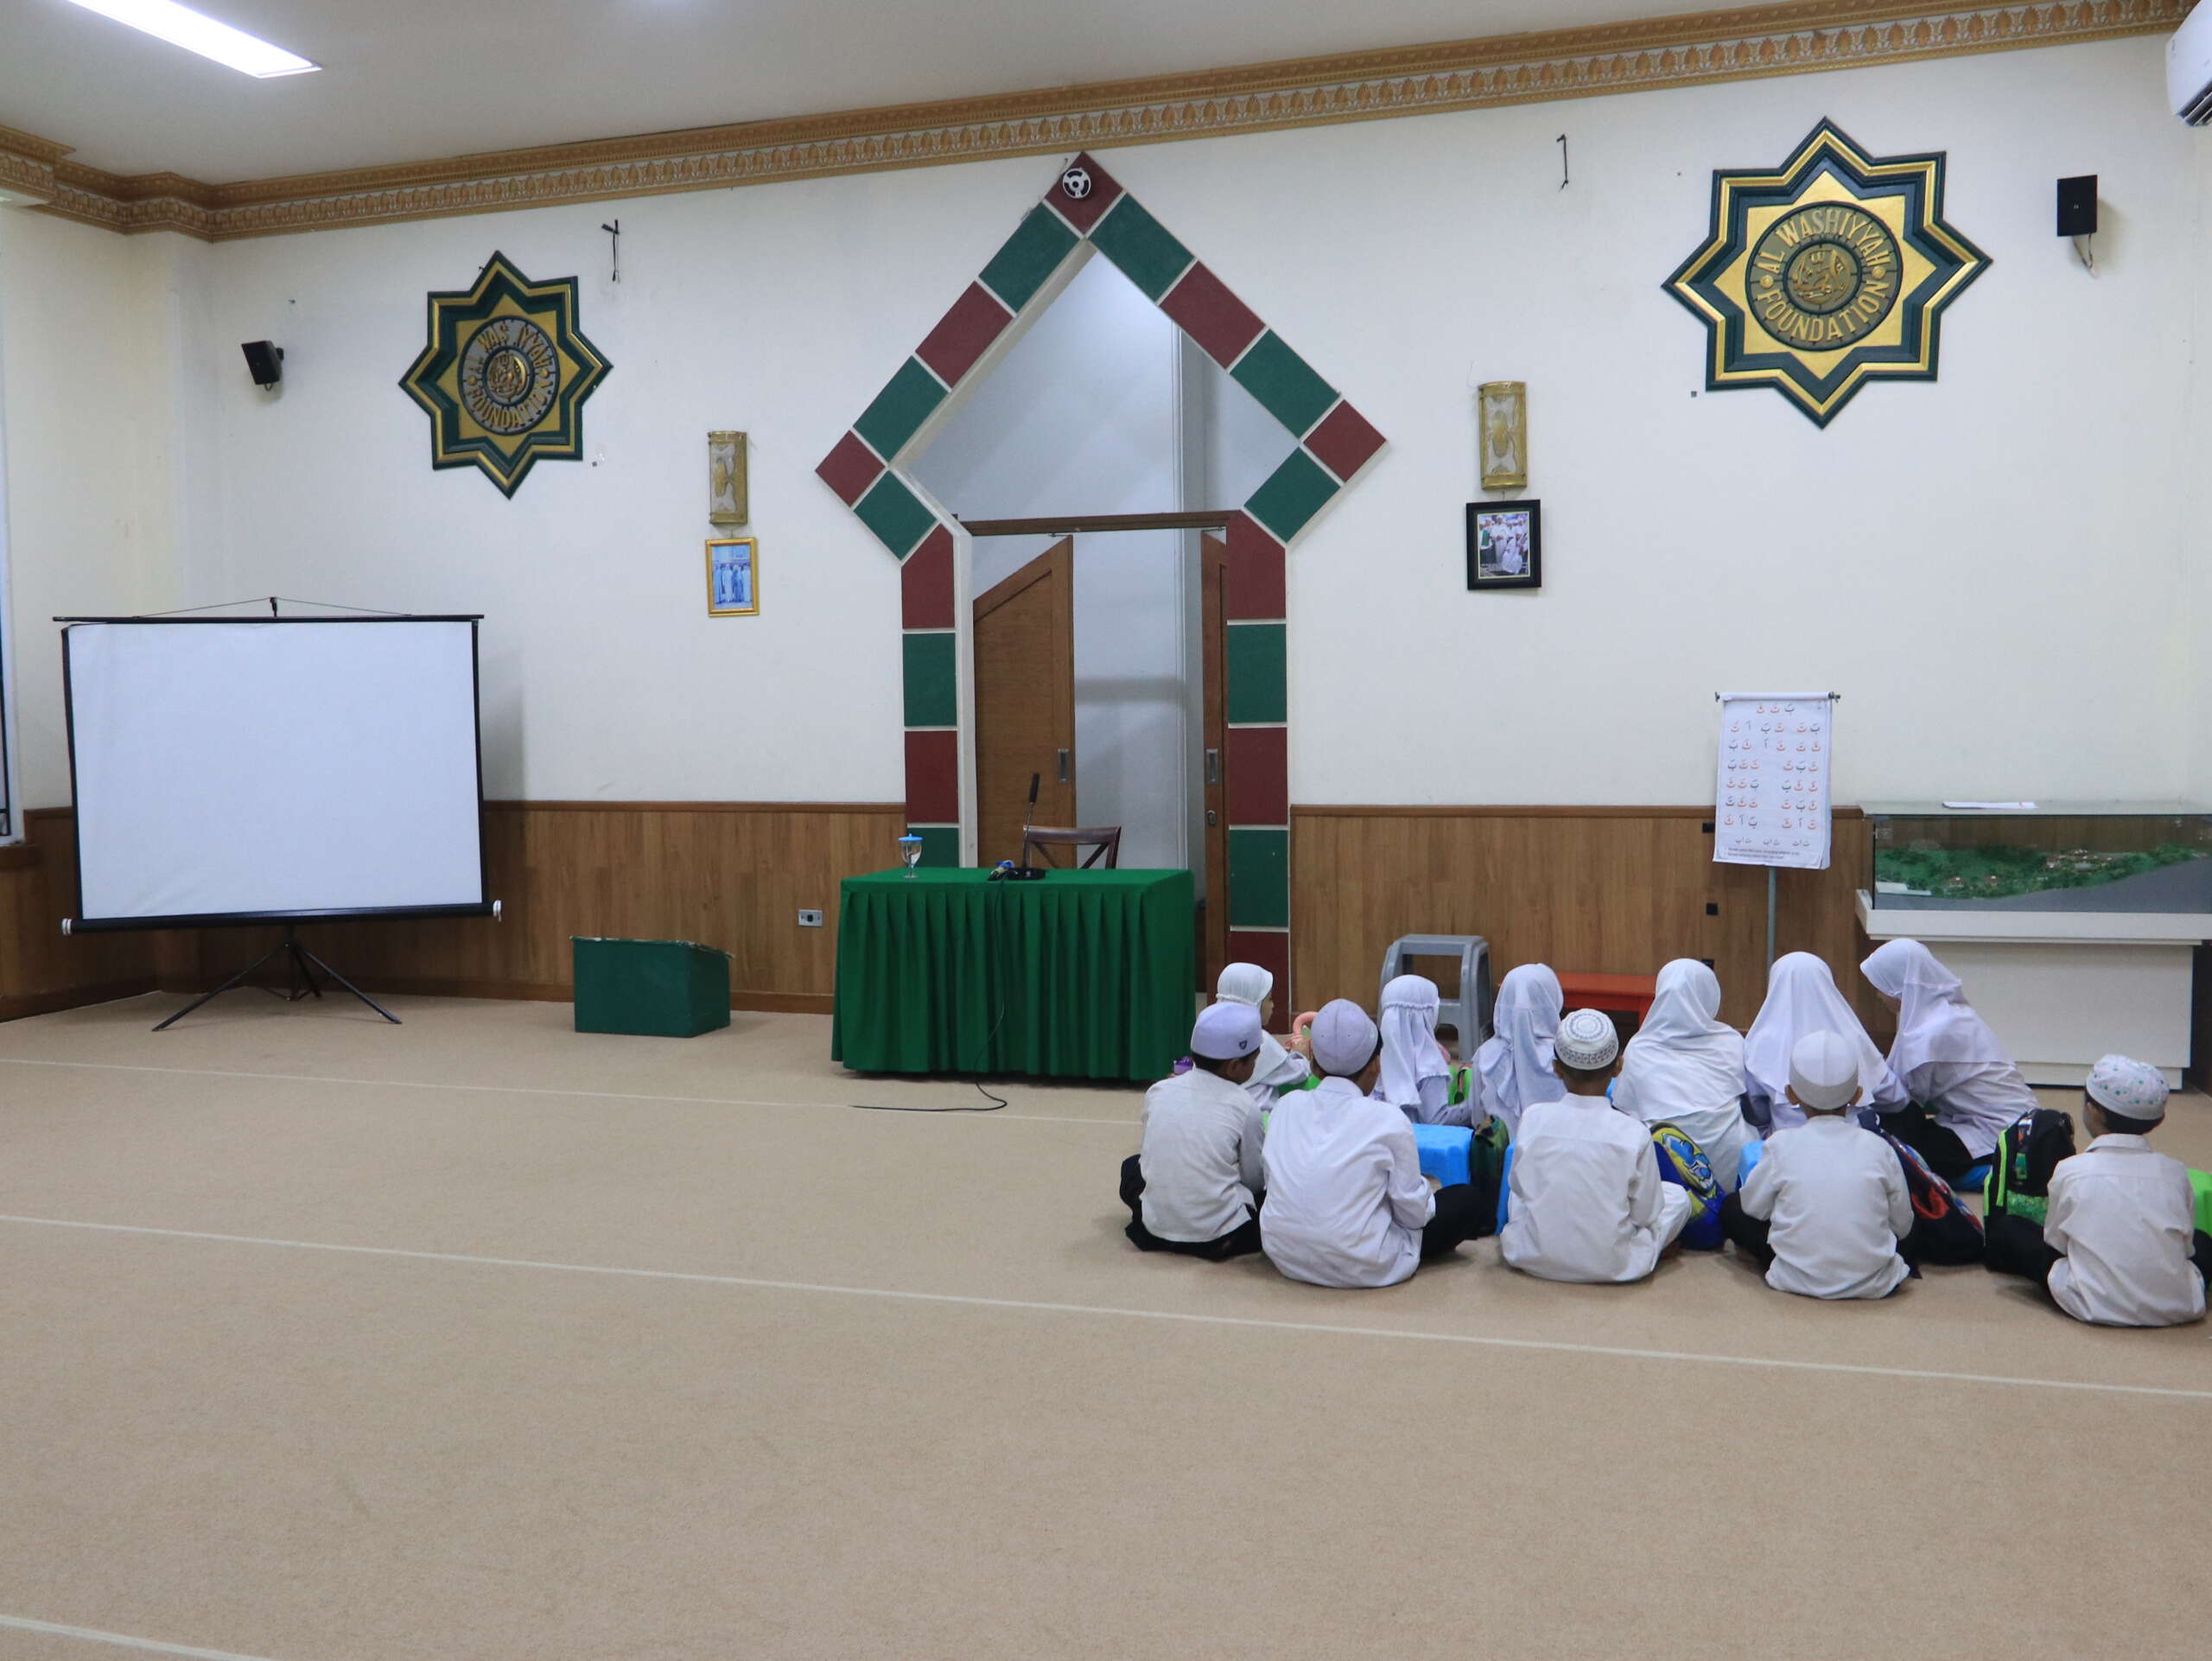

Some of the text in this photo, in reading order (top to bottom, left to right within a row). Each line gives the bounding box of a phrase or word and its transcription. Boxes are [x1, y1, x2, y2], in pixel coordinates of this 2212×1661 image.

[1757, 208, 1891, 273] AL WASHIYYAH
[1756, 280, 1890, 342] FOUNDATION
[477, 325, 553, 369] WASIYYAH
